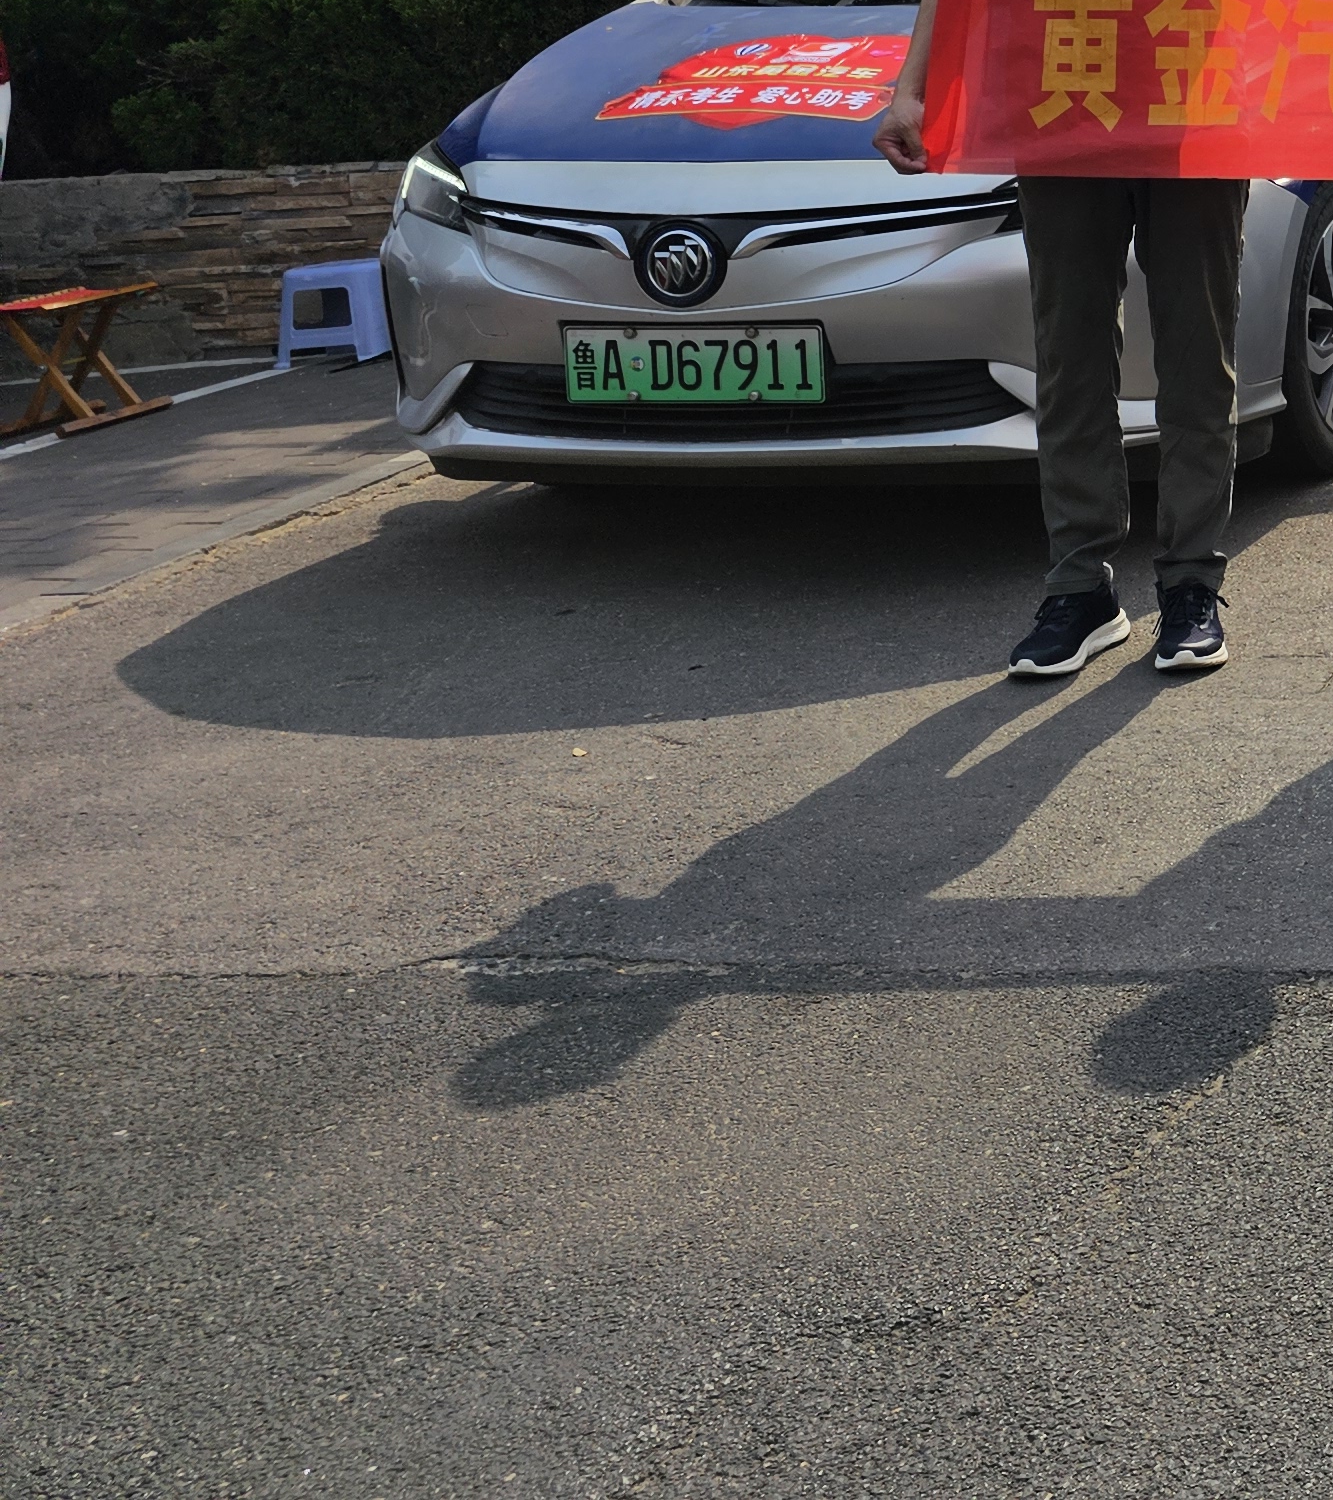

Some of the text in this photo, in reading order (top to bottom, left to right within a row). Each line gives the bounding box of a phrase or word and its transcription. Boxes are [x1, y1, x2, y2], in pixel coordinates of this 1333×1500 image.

[629, 87, 874, 109] 情系考生 爱心助考
